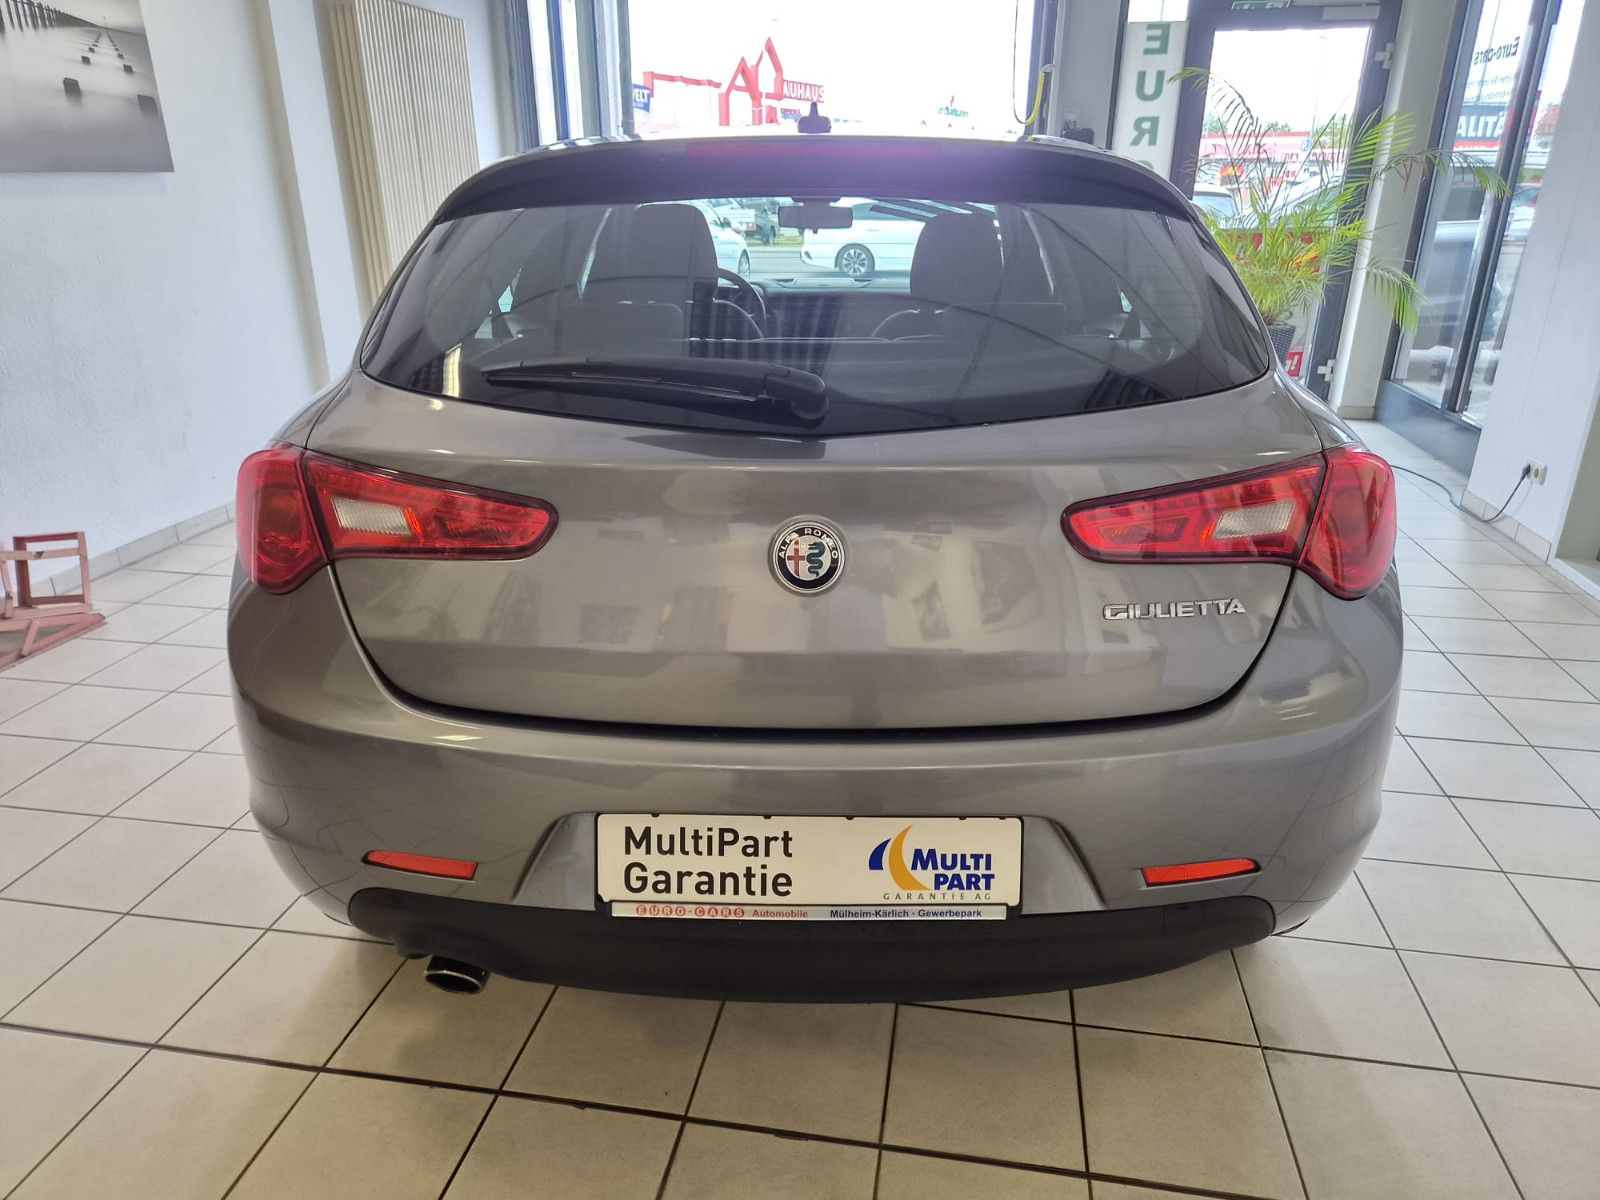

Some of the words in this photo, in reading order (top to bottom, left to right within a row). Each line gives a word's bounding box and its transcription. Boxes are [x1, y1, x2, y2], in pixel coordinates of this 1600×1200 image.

[778, 532, 800, 559] ALFA
[804, 528, 839, 559] ROMEO
[1102, 598, 1246, 620] GIULIETTA
[624, 826, 793, 858] MultiPart
[910, 848, 992, 871] MULTI
[624, 861, 793, 897] Garantie
[933, 873, 995, 891] PART
[883, 892, 966, 901] GARANTIE
[974, 892, 992, 901] AG
[636, 903, 745, 918] EURO-CARS
[752, 908, 809, 919] Automobile
[830, 908, 909, 919] Mülheim-Kärlich
[917, 908, 982, 919] Gewerbepark
